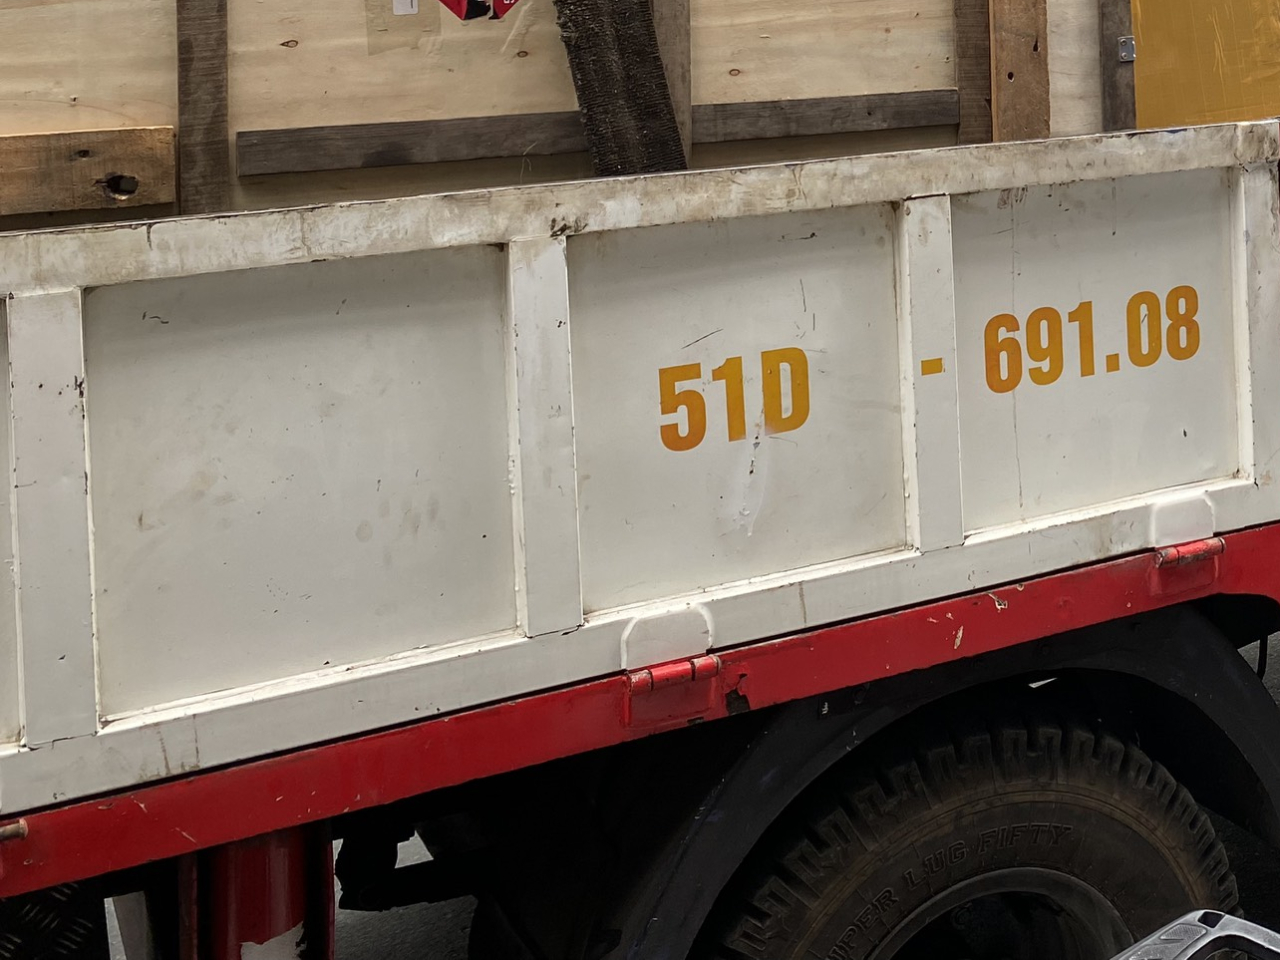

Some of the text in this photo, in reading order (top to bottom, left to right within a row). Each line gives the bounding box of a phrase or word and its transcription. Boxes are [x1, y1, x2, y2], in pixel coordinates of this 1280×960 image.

[658, 346, 811, 453] 51D
[983, 284, 1201, 395] 691.08
[904, 840, 967, 890] LUG
[977, 822, 1074, 854] FIFTY
